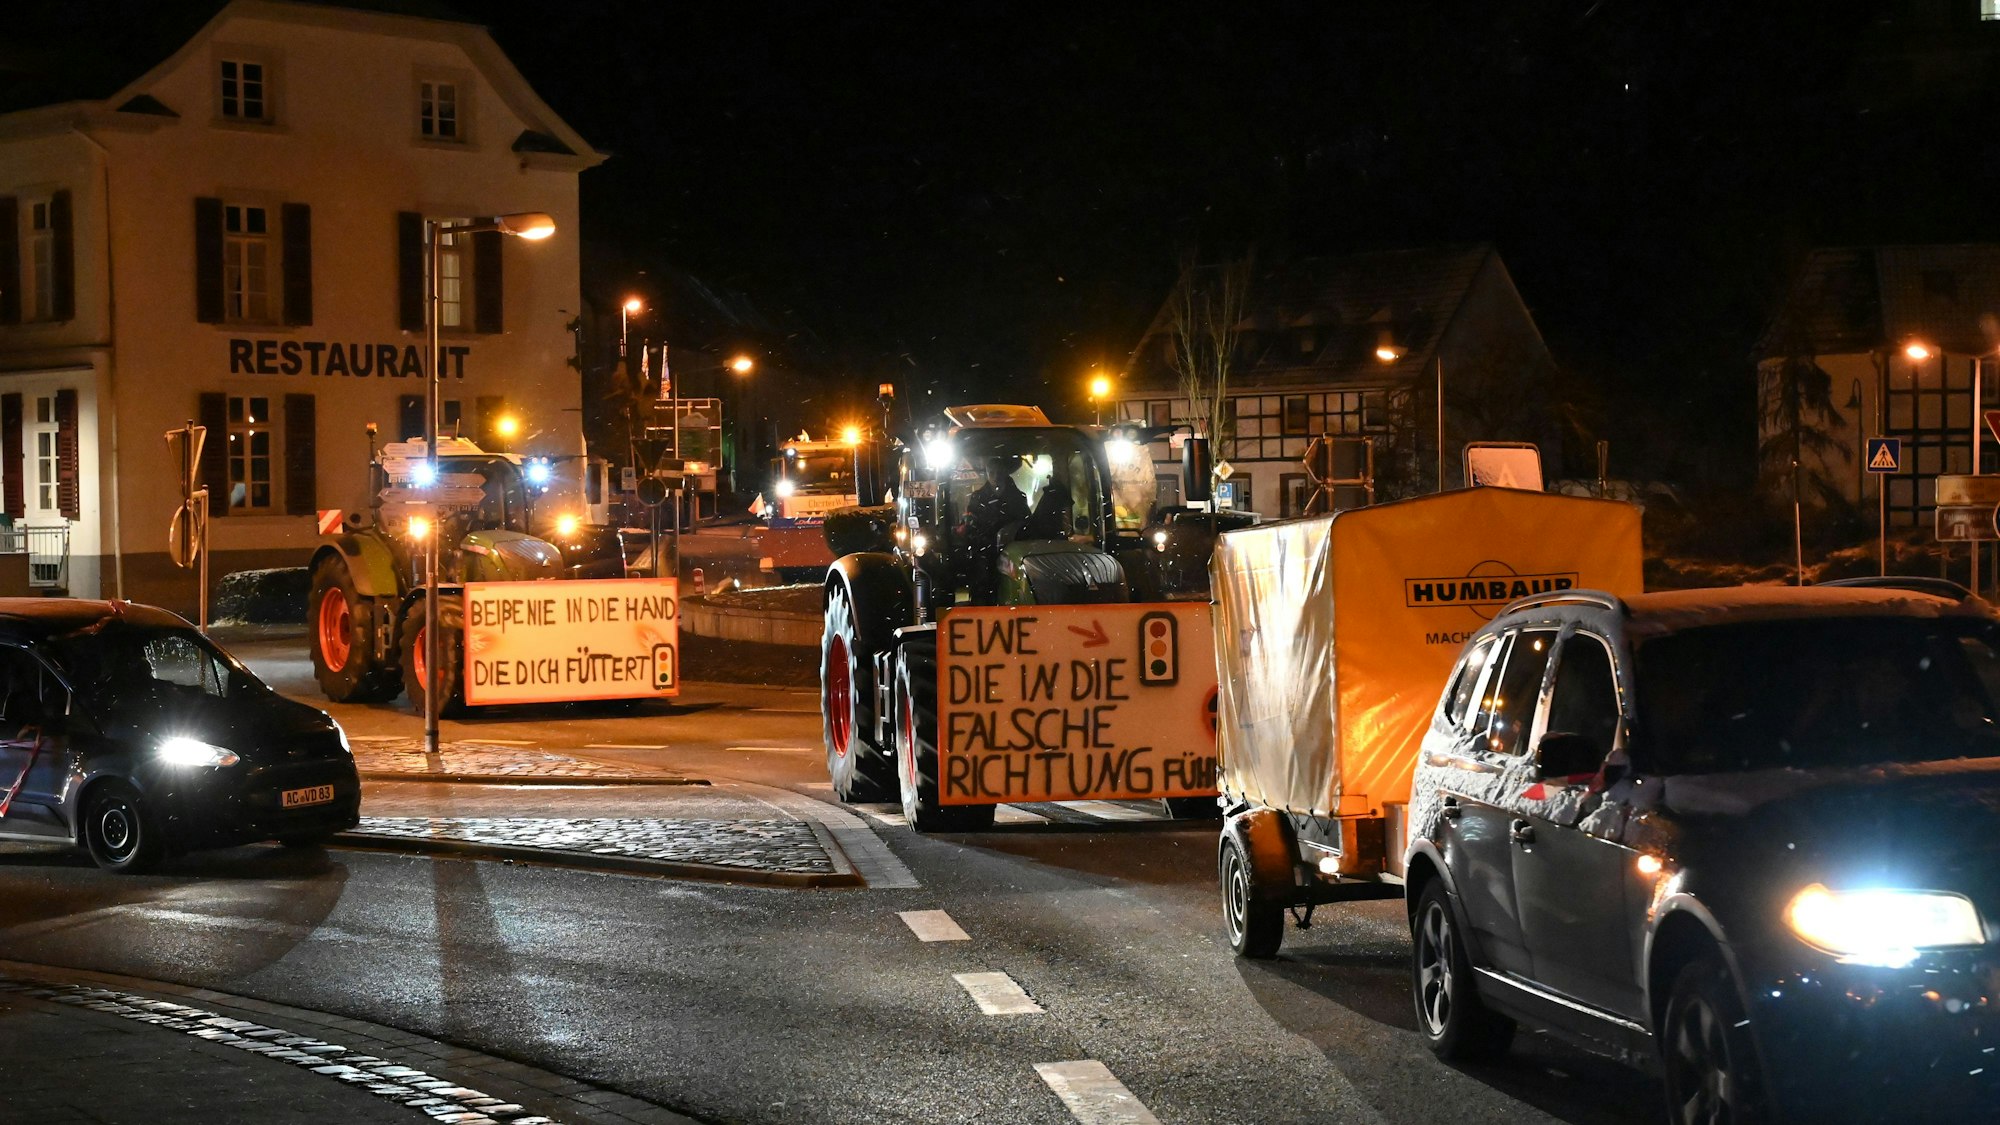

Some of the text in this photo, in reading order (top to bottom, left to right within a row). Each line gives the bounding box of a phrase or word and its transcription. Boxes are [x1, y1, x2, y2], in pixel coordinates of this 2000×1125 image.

[1413, 578, 1572, 602] HUMBAUR
[527, 599, 556, 626] NIE
[567, 597, 583, 623] IN
[588, 597, 620, 623] DIE
[626, 595, 676, 622] HAND
[1426, 631, 1475, 645] MACH
[474, 646, 651, 686] DIE DICH FÜTTERT
[948, 658, 1130, 705] DIE IN DIE
[948, 704, 1118, 753] FALSCHE
[947, 747, 1217, 798] RICHTUNG FÜH
[286, 786, 331, 805] AC VD 83
